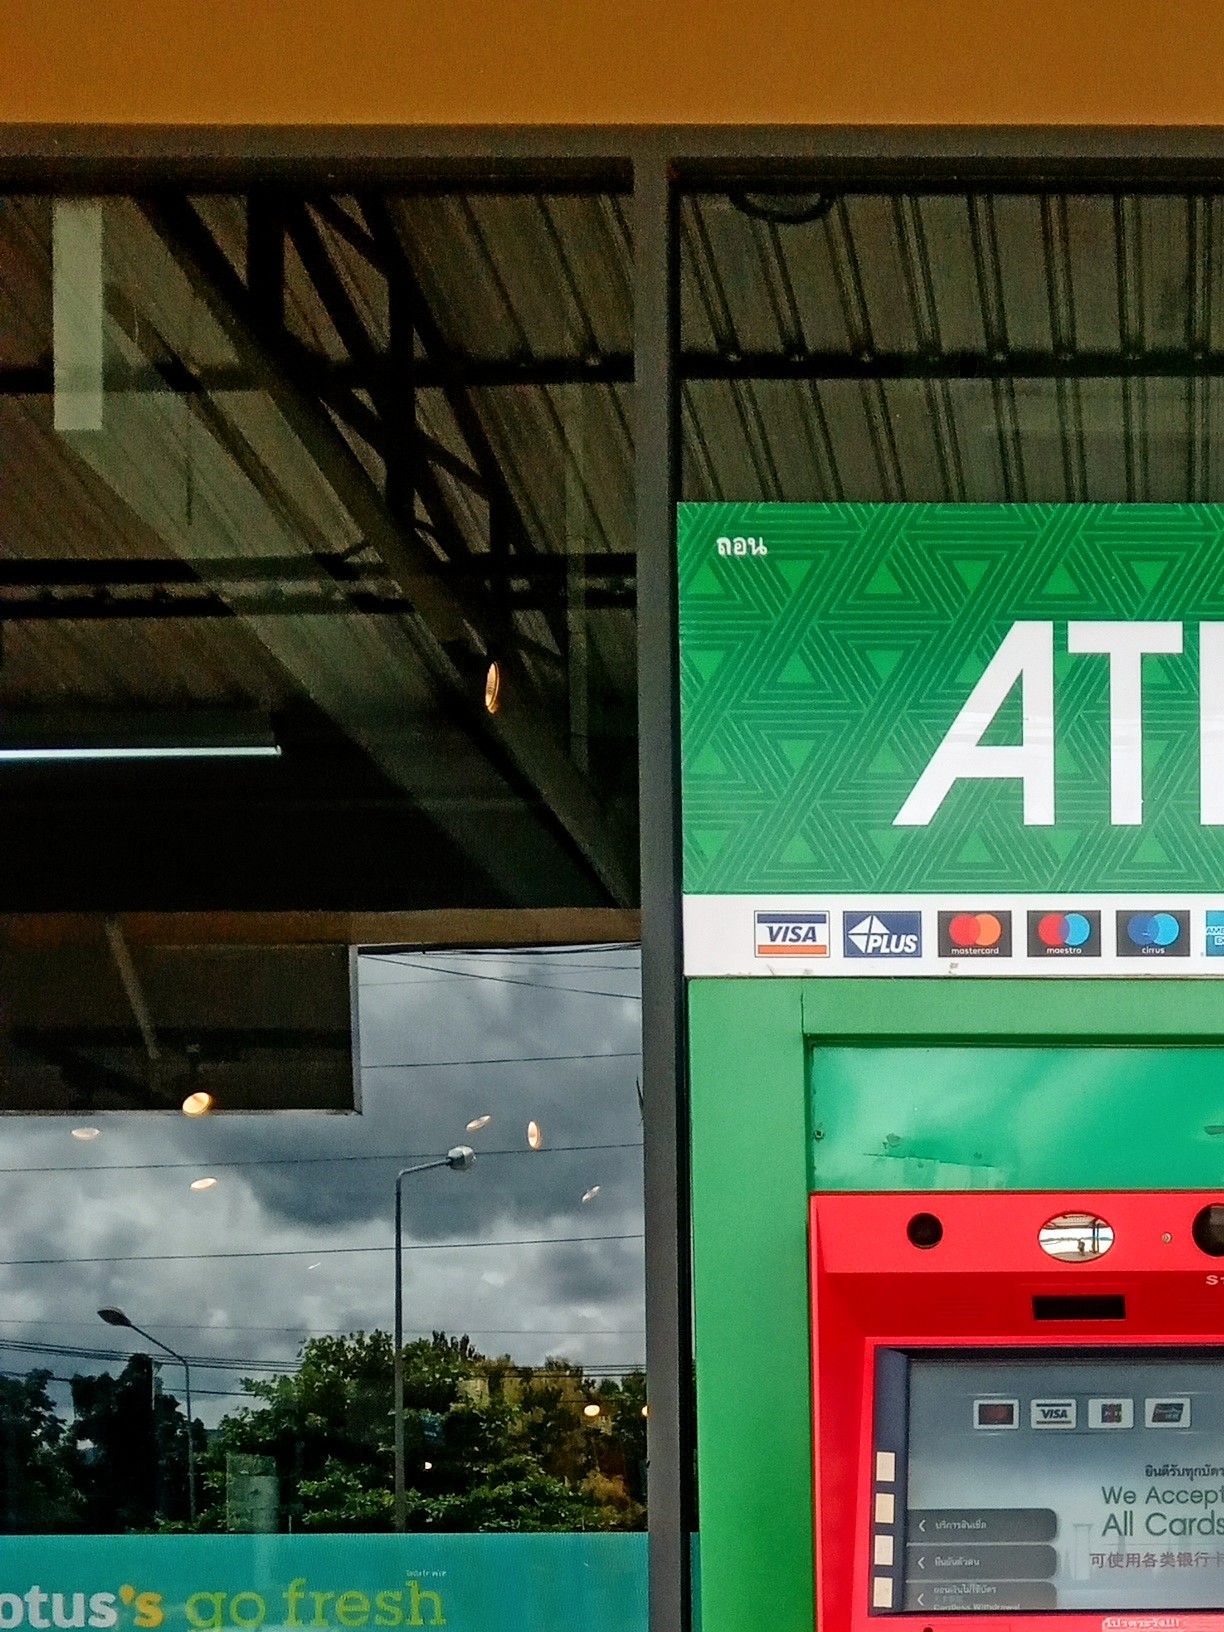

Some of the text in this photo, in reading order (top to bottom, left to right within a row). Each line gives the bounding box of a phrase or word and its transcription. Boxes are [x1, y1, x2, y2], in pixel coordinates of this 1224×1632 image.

[716, 536, 768, 556] ถอน
[766, 925, 818, 943] VISA
[867, 933, 918, 954] PLUS
[950, 946, 1000, 956] mastercard
[1046, 946, 1082, 955] maestro
[1141, 946, 1165, 955] cirrus
[1041, 1408, 1068, 1419] VISA
[1101, 1485, 1137, 1505] We
[1100, 1510, 1134, 1537] All
[283, 1577, 447, 1627] fresh
